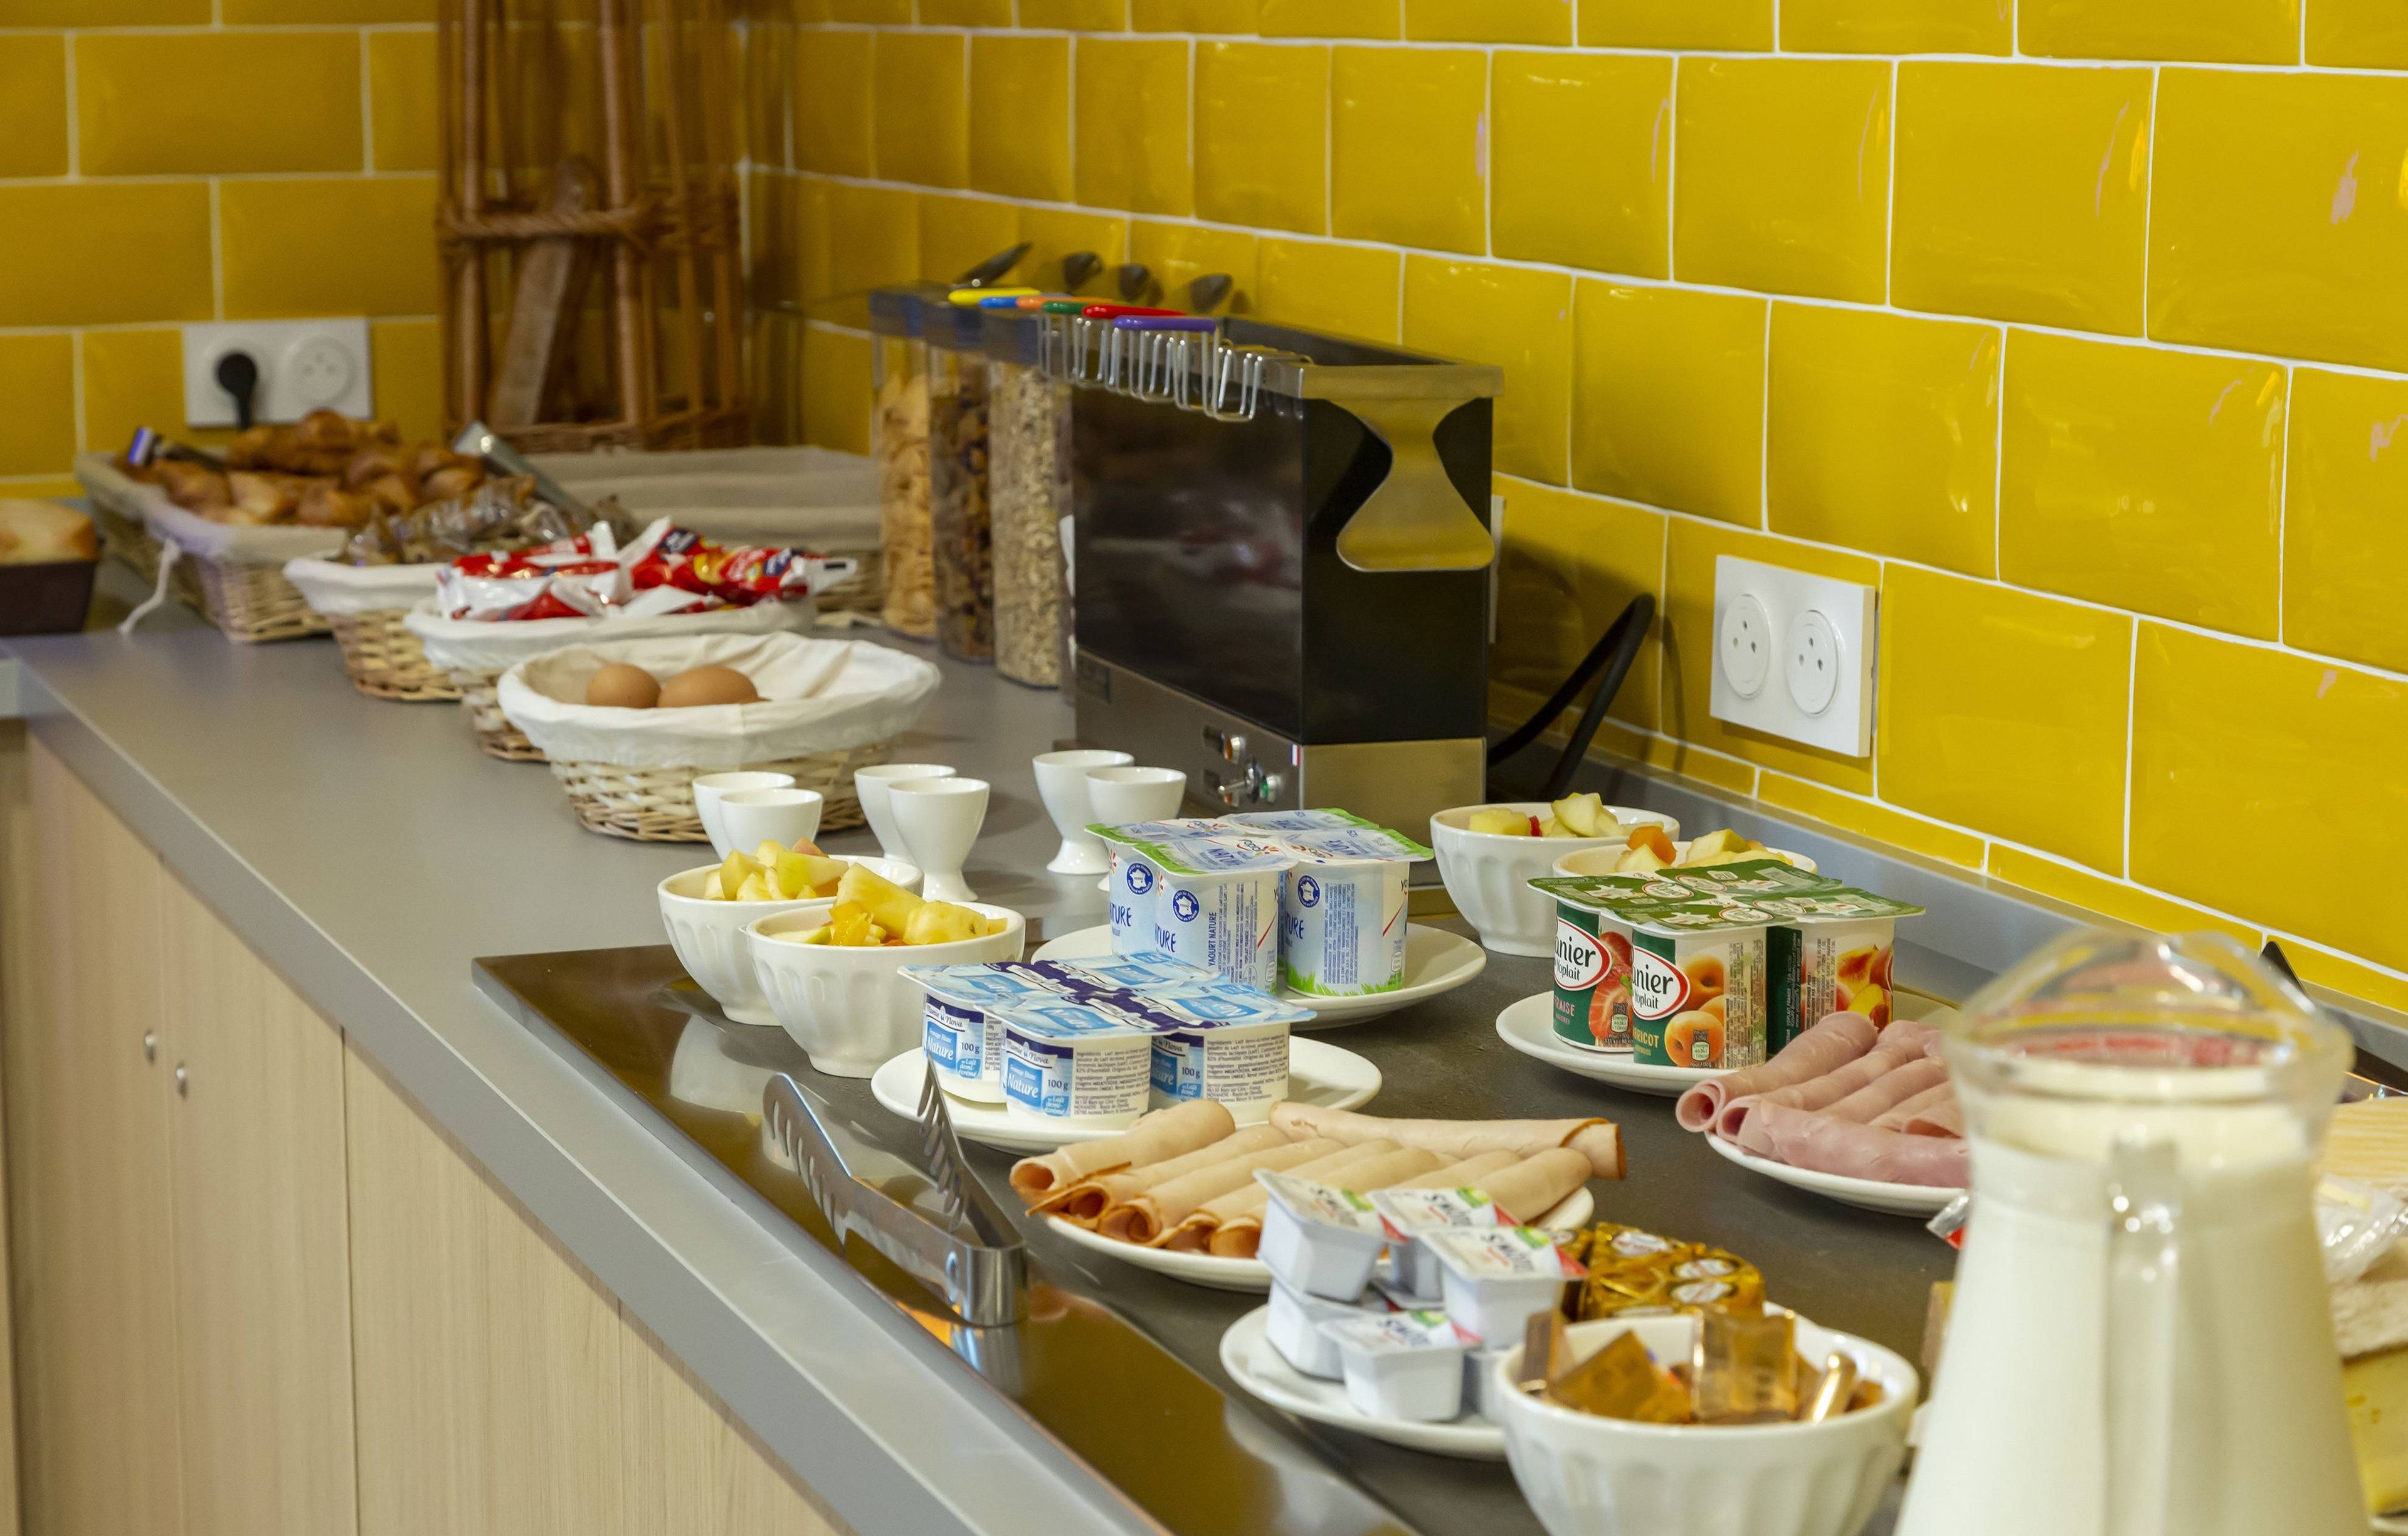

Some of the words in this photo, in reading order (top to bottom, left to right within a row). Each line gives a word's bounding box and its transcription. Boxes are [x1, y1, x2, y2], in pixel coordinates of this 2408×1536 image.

[1110, 902, 1131, 927] TURE
[1208, 911, 1217, 938] NATURE
[1287, 913, 1304, 940] TURE
[1155, 923, 1176, 953] TURE
[1208, 938, 1217, 967] YAOURT
[1555, 936, 1596, 967] anier
[1632, 963, 1674, 995] anier
[945, 1016, 963, 1028] Nova
[927, 1035, 954, 1061] Nature
[961, 1042, 974, 1051] 100
[974, 1046, 980, 1055] g
[1028, 1051, 1050, 1065] Nova
[1151, 1067, 1175, 1085] ature
[1181, 1066, 1195, 1076] 100
[1195, 1071, 1200, 1079] g
[1007, 1073, 1038, 1098] Nature
[1047, 1079, 1061, 1088] 100
[1062, 1082, 1069, 1092] g
